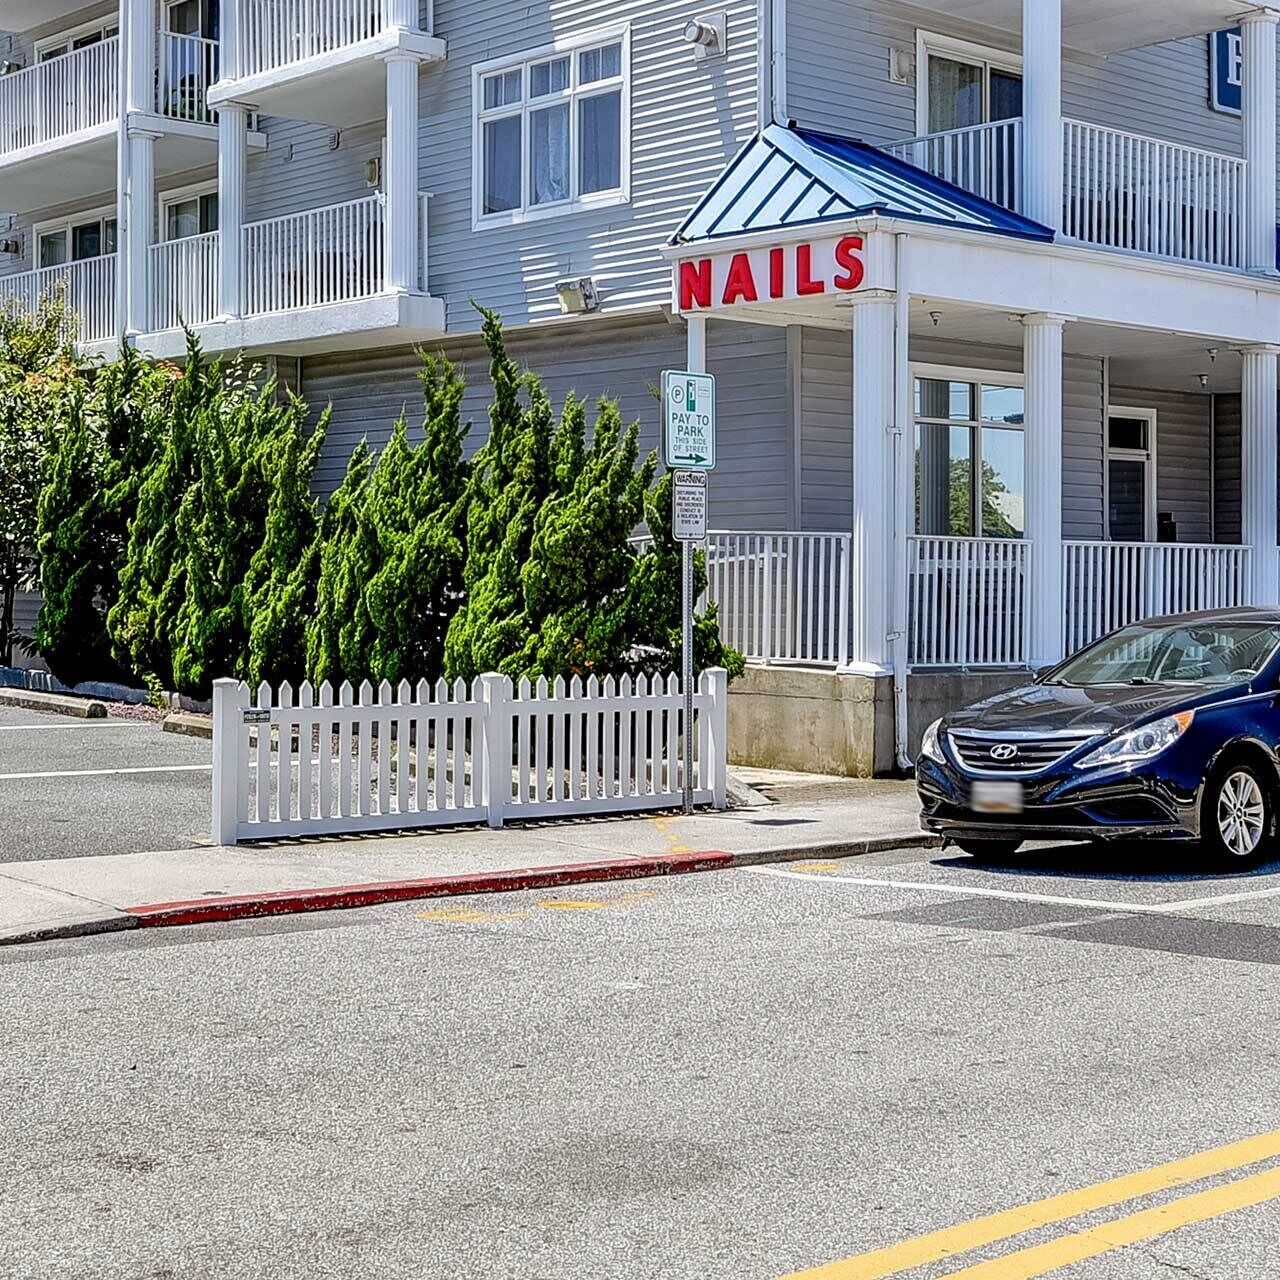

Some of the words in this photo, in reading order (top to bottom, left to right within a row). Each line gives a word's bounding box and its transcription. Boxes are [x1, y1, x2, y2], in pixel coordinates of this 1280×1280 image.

[680, 236, 864, 311] NAILS
[674, 389, 681, 399] P
[672, 412, 691, 424] PAY
[696, 414, 709, 426] TO
[677, 425, 704, 438] PARK
[693, 438, 706, 446] SIDE
[685, 445, 708, 454] STREET
[676, 474, 705, 485] WARNING
